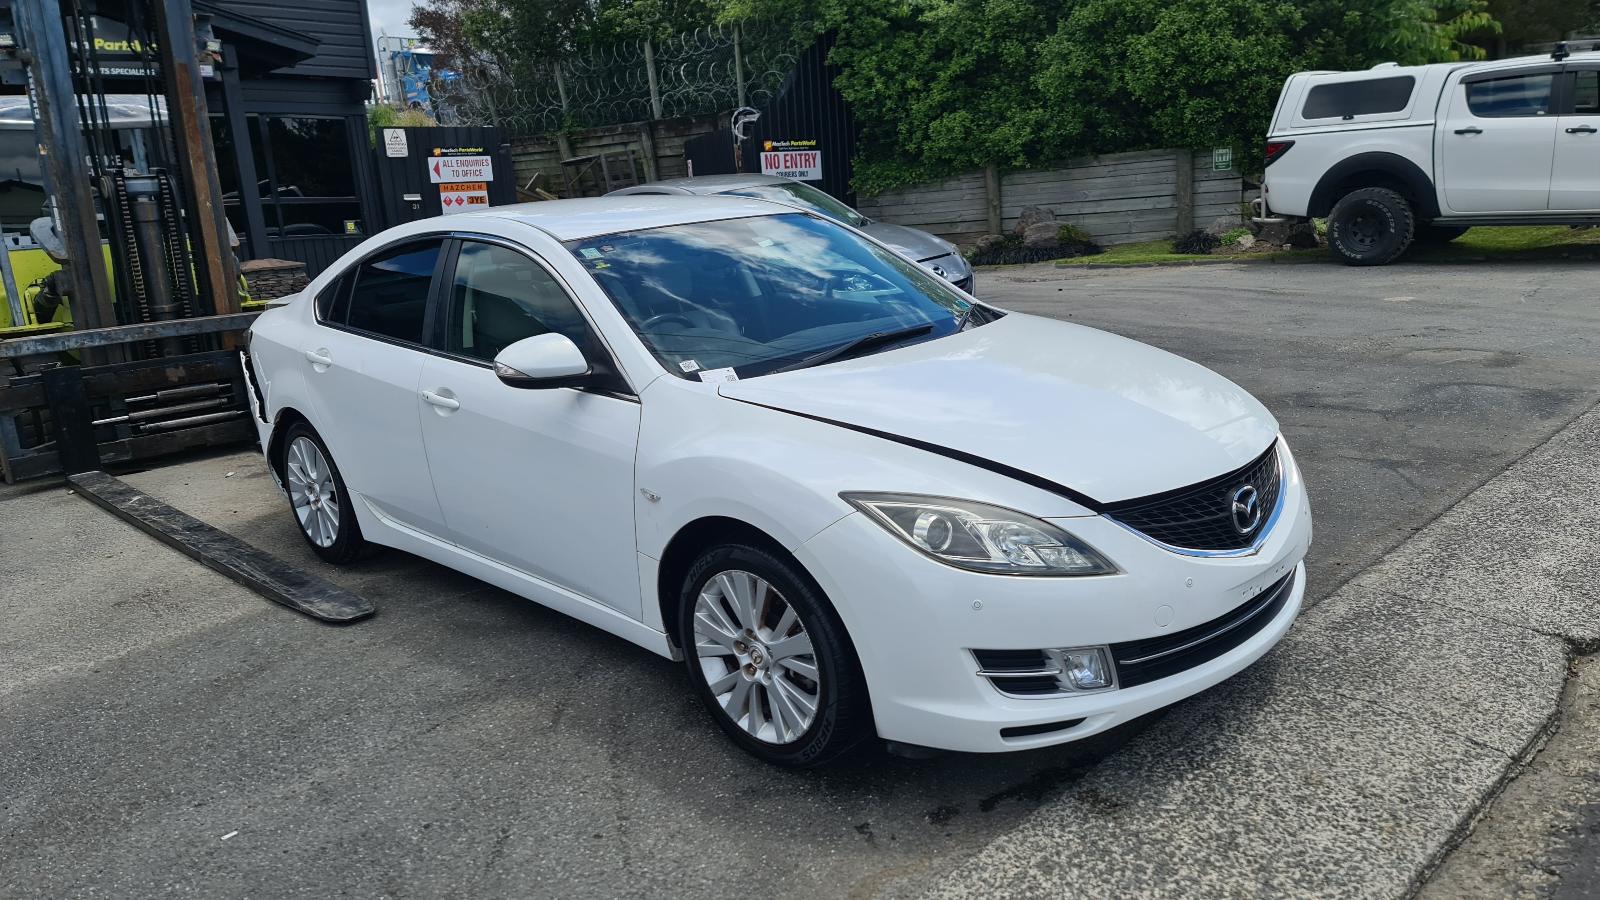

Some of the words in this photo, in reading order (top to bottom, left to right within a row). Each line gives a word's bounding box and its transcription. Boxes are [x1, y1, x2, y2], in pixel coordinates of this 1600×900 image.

[442, 159, 455, 168] ALL
[456, 158, 490, 168] ENQUIRIES
[764, 154, 780, 169] NO
[784, 153, 817, 169] ENTRY
[451, 169, 460, 178] TO
[461, 169, 484, 178] OFFICE
[443, 183, 483, 191] HAZCHEM
[468, 196, 485, 204] 3YE
